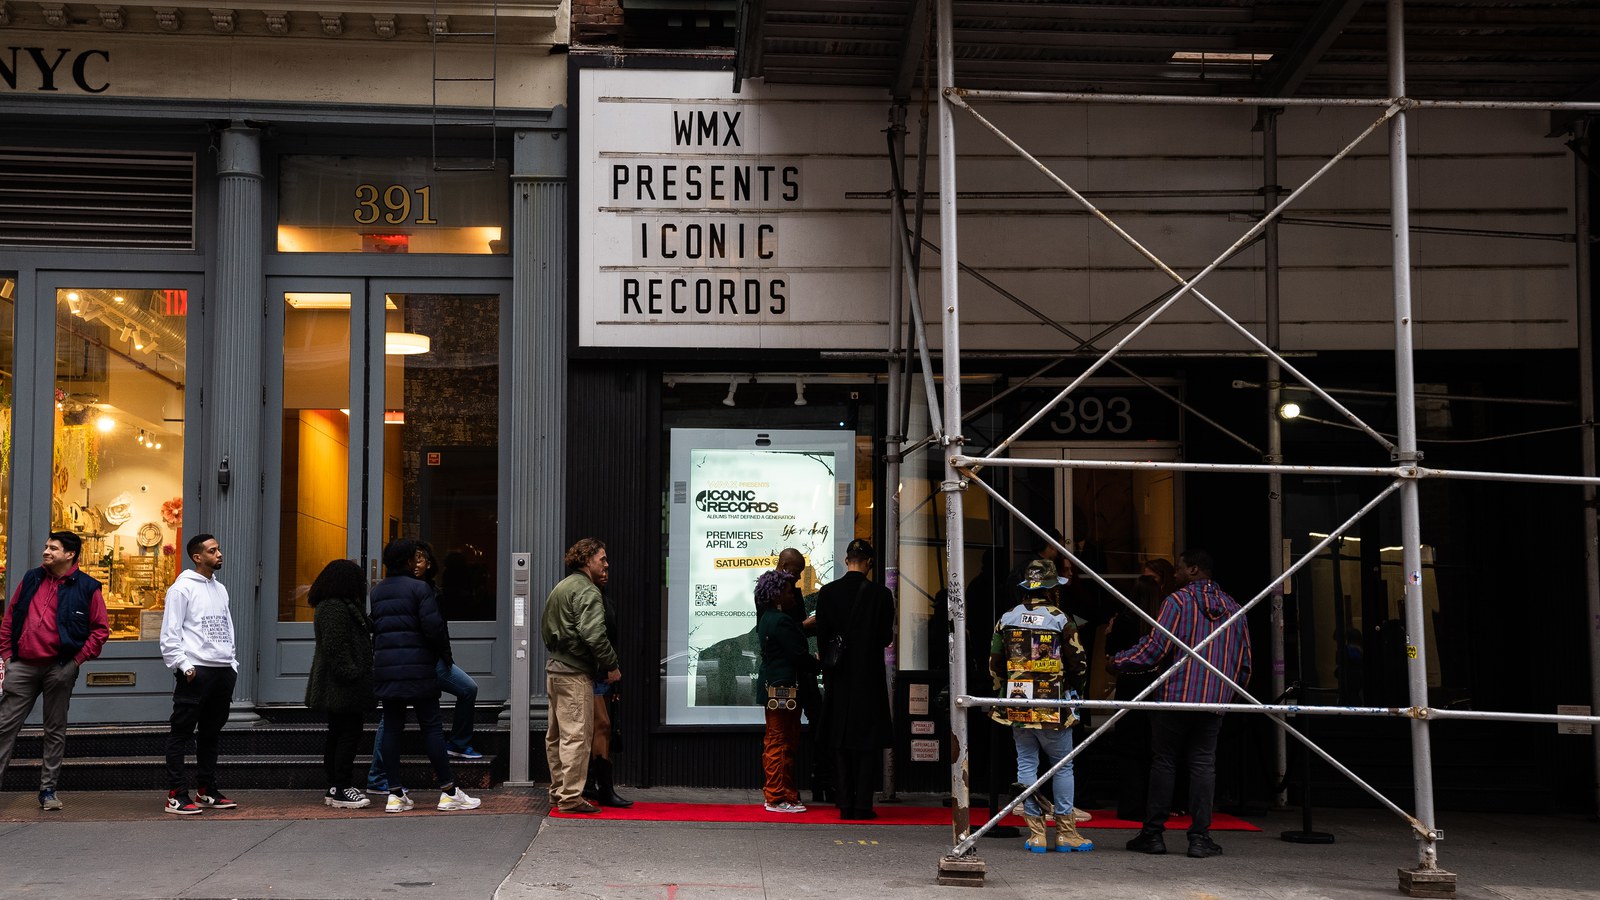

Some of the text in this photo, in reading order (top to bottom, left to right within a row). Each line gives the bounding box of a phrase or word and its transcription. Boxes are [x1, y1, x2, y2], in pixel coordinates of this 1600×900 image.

[673, 111, 741, 146] WMX
[612, 164, 799, 201] PRESENTS
[353, 184, 437, 224] 391
[641, 223, 774, 259] ICONIC
[623, 279, 786, 314] RECORDS
[1050, 397, 1132, 433] 393
[707, 490, 756, 501] ICONIC
[707, 502, 779, 513] RECORDS
[705, 540, 748, 549] APRIL 29
[706, 531, 764, 540] PREMIERES
[716, 558, 771, 568] SATURDAYS
